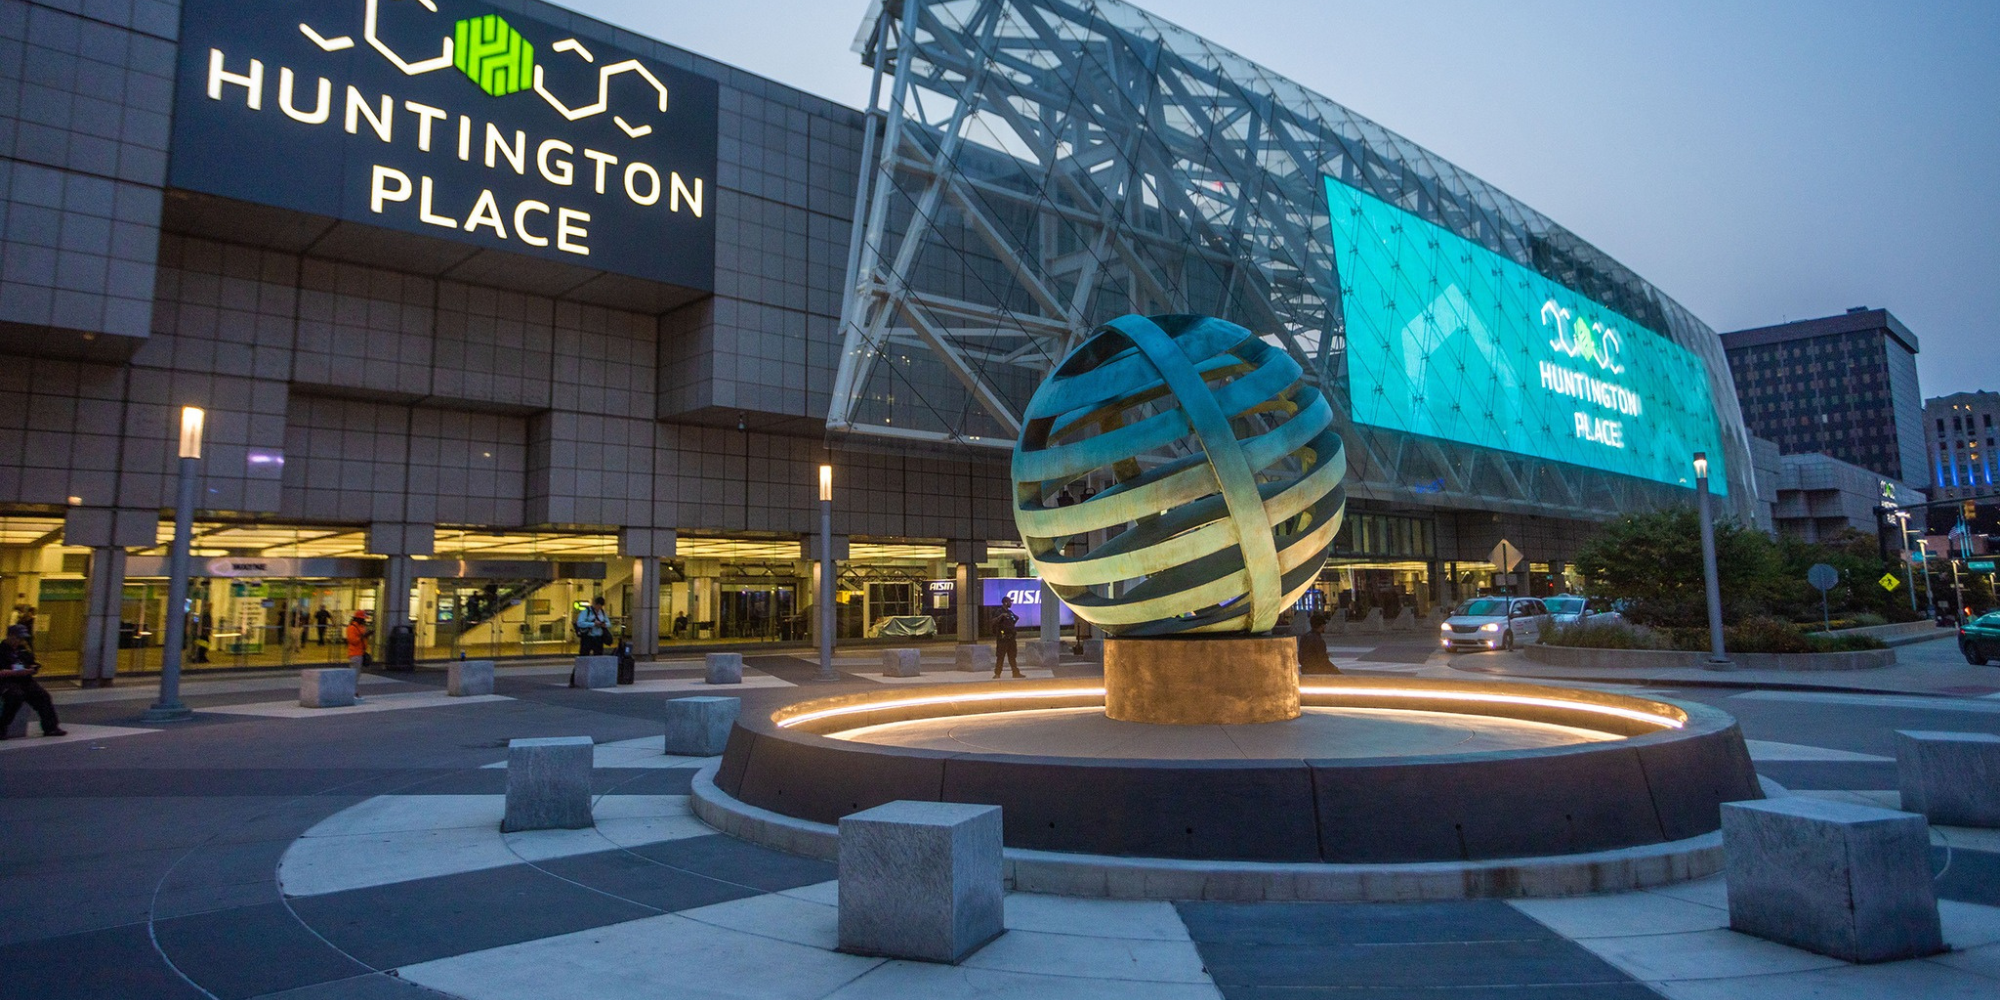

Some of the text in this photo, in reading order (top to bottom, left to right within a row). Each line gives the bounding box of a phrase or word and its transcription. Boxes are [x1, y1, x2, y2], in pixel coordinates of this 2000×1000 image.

[207, 48, 703, 218] HUNTINGTON
[370, 164, 591, 256] PLACE
[1539, 360, 1640, 417] HUNTINGTON
[1574, 411, 1623, 448] PLACE
[929, 582, 954, 591] AISIN
[1006, 590, 1042, 604] AISI
